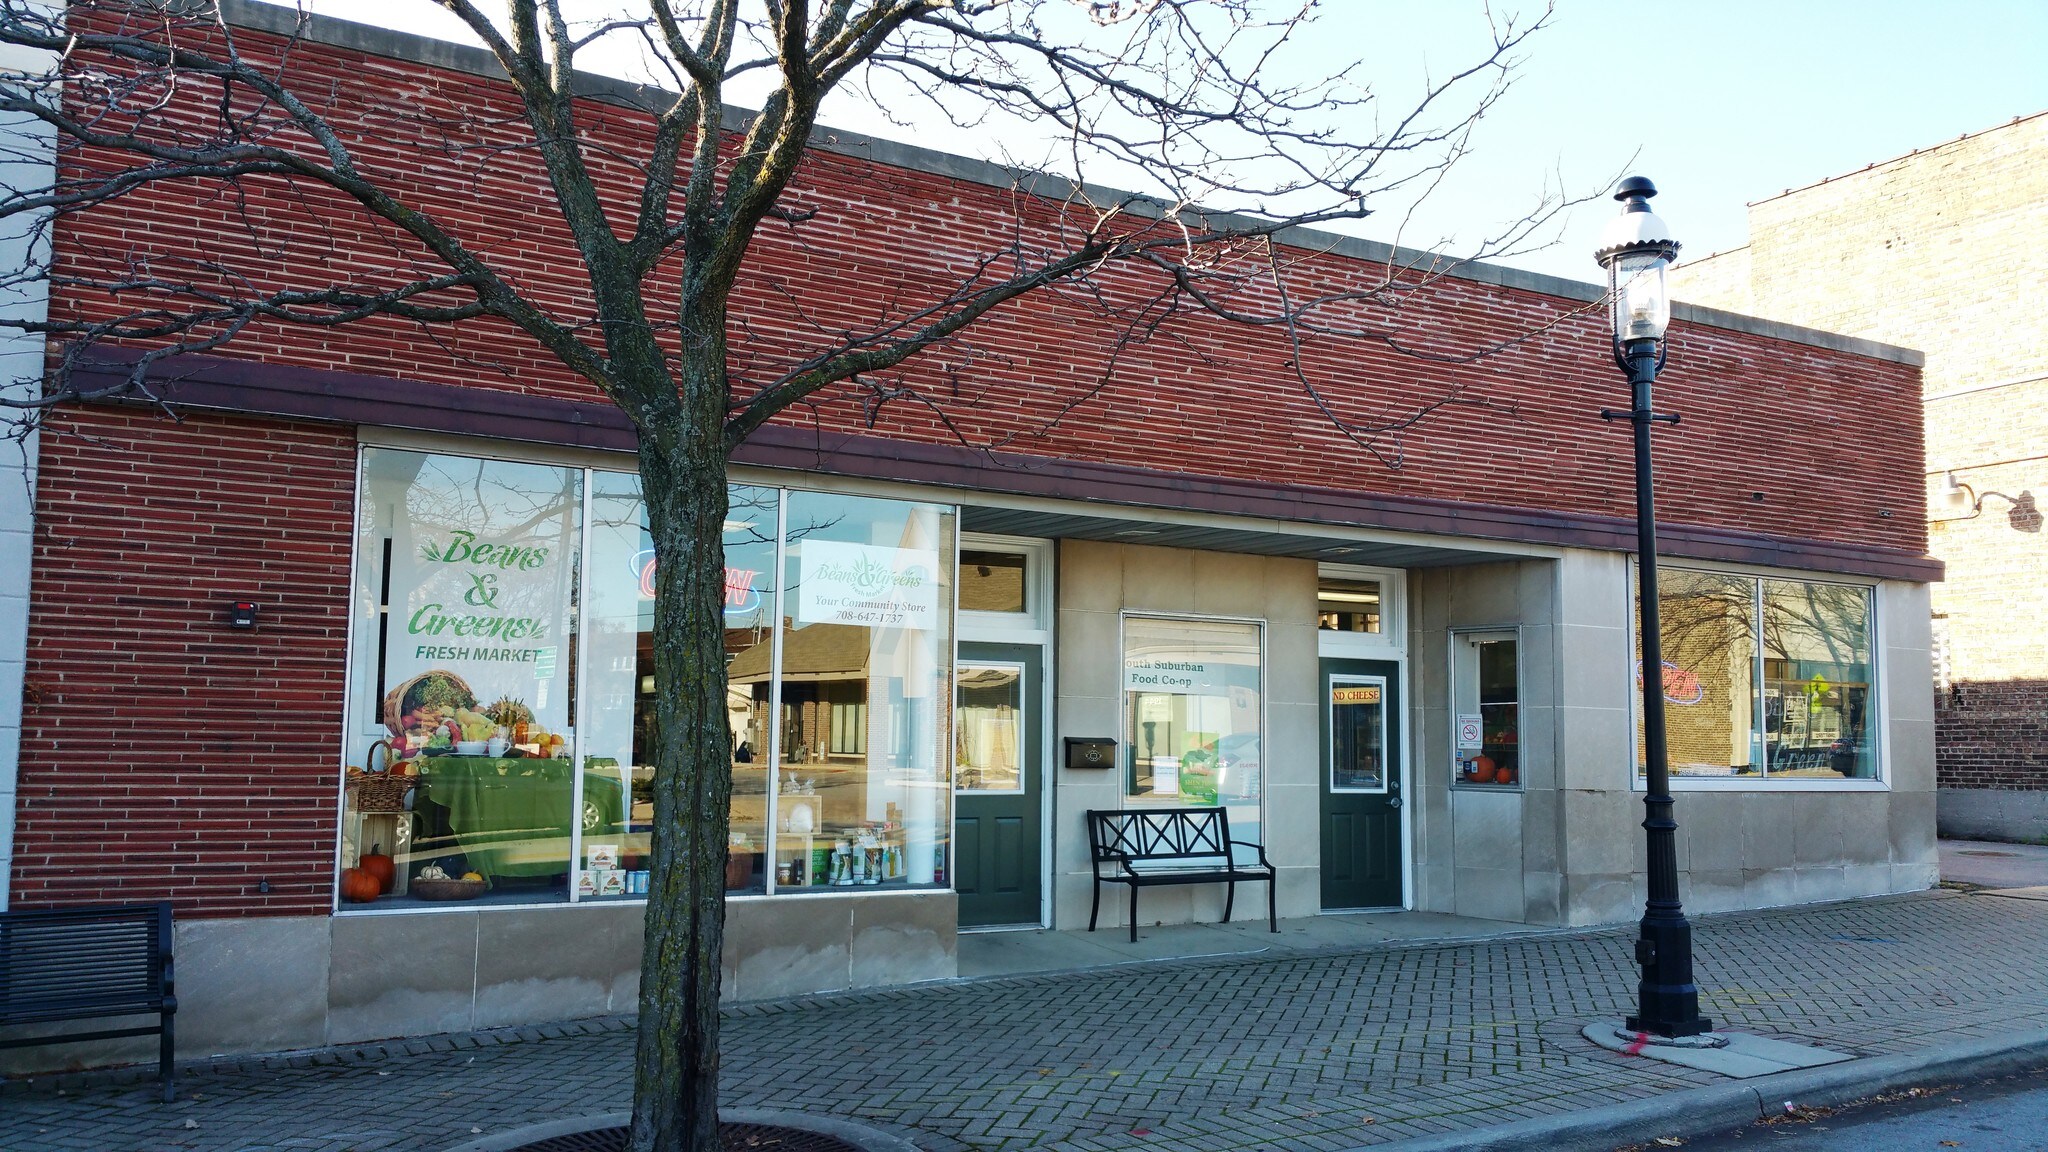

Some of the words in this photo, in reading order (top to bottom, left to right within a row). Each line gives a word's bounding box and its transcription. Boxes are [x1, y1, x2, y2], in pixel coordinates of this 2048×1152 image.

[442, 530, 549, 571] Beans
[816, 563, 857, 584] Beans
[876, 568, 922, 588] Greens
[463, 571, 499, 609] &
[815, 595, 839, 606] Your
[841, 597, 900, 613] Community
[901, 601, 926, 613] Store
[408, 603, 533, 642] Greens
[835, 610, 903, 624] 708-647-1737
[415, 646, 470, 661] FRESH
[472, 647, 542, 663] MARKET
[1126, 659, 1151, 669] outh
[1154, 660, 1204, 672] Suburban
[1131, 673, 1158, 684] Food
[1161, 675, 1192, 688] Co-op
[1347, 690, 1379, 701] CHEESE
